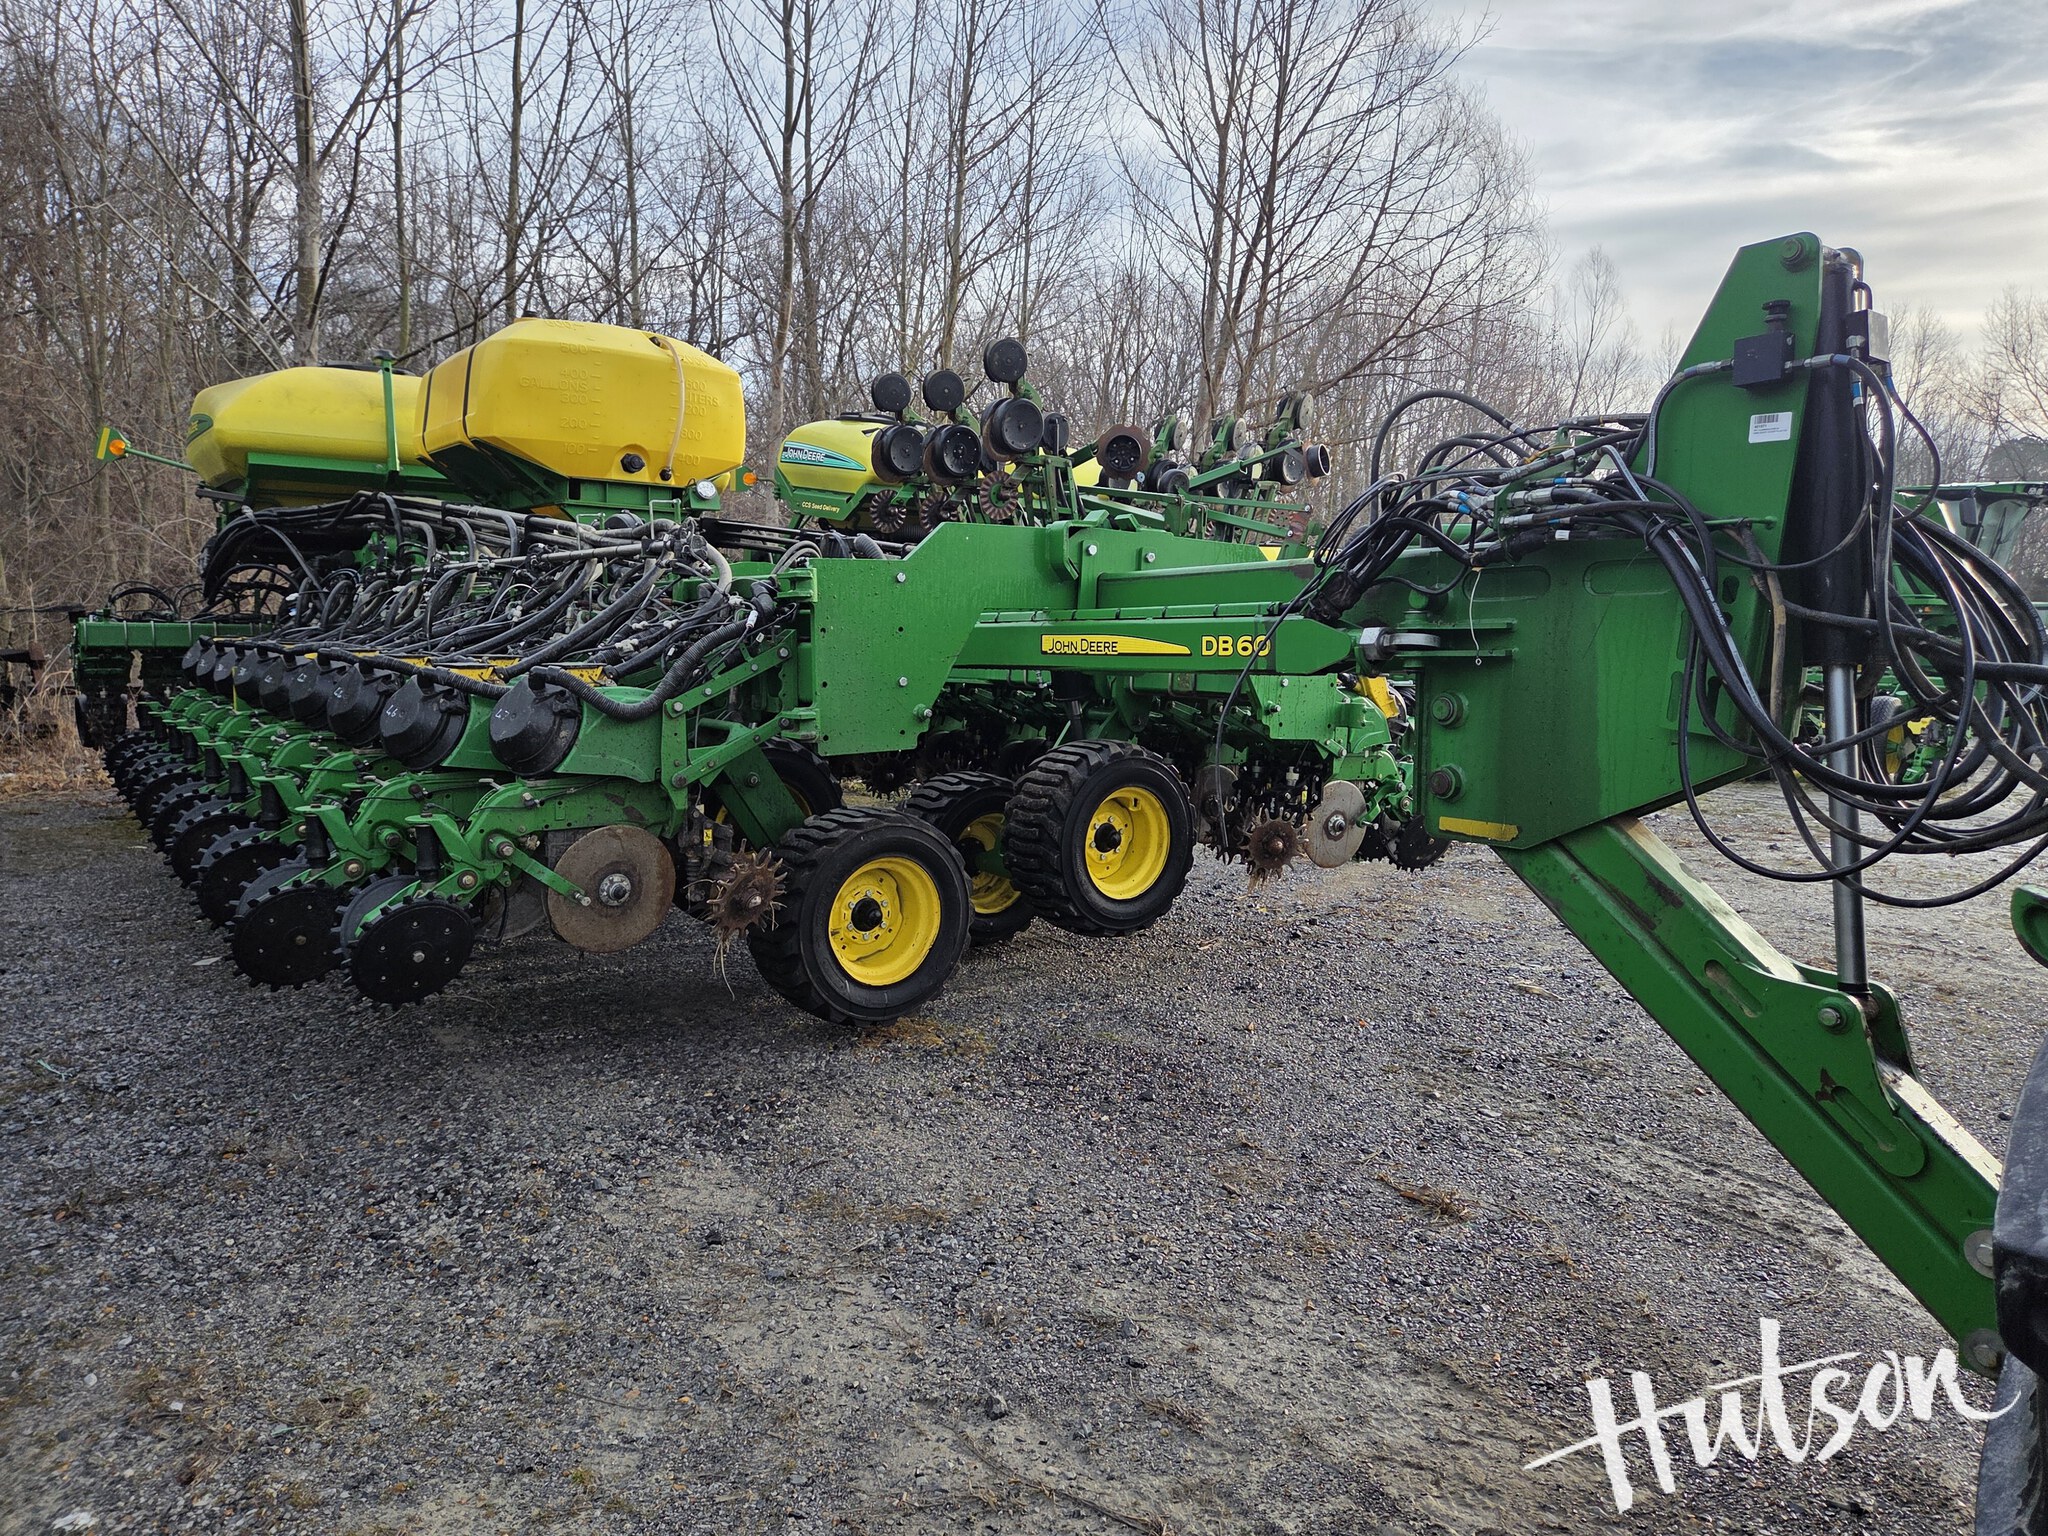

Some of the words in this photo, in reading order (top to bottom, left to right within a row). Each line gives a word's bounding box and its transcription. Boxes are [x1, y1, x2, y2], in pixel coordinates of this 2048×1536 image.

[560, 342, 588, 355] 500
[560, 367, 588, 380] 400
[519, 375, 588, 393] GALLONS
[560, 392, 588, 405] 300
[684, 404, 708, 417] 200
[560, 416, 588, 430] 200
[562, 442, 587, 455] 100
[786, 447, 803, 460] JOHN
[803, 450, 825, 461] DEERE
[823, 504, 840, 513] Delivery
[1048, 638, 1080, 653] JOHN
[1080, 638, 1119, 654] DEERE
[385, 704, 398, 718] 46
